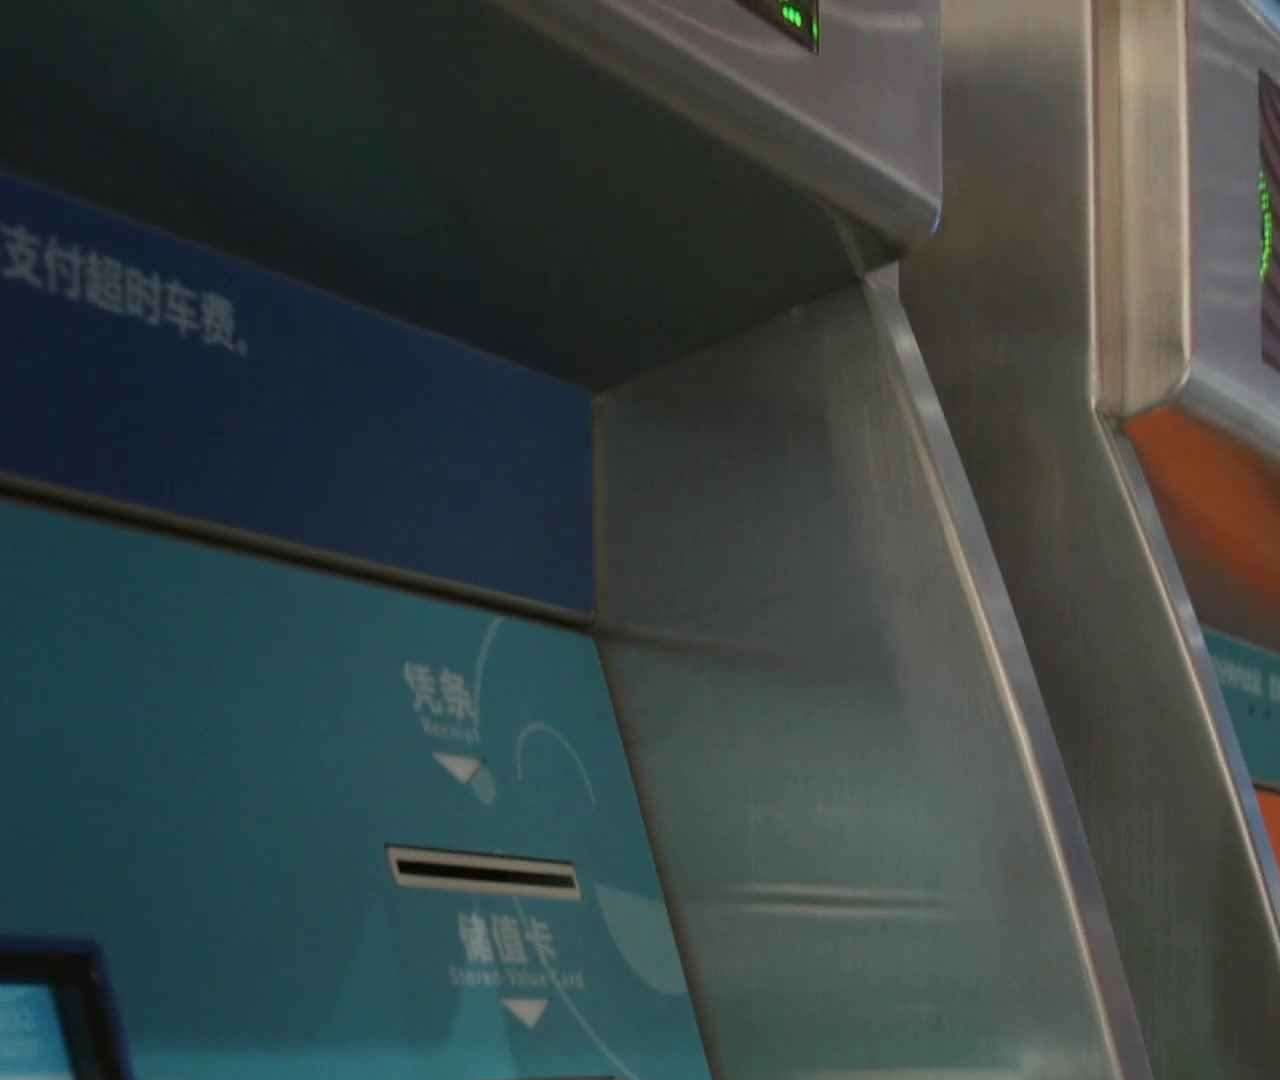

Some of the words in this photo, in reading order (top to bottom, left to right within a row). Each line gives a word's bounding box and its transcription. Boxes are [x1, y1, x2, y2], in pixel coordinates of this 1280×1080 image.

[404, 661, 475, 720] 凭条
[457, 912, 557, 963] 储值卡
